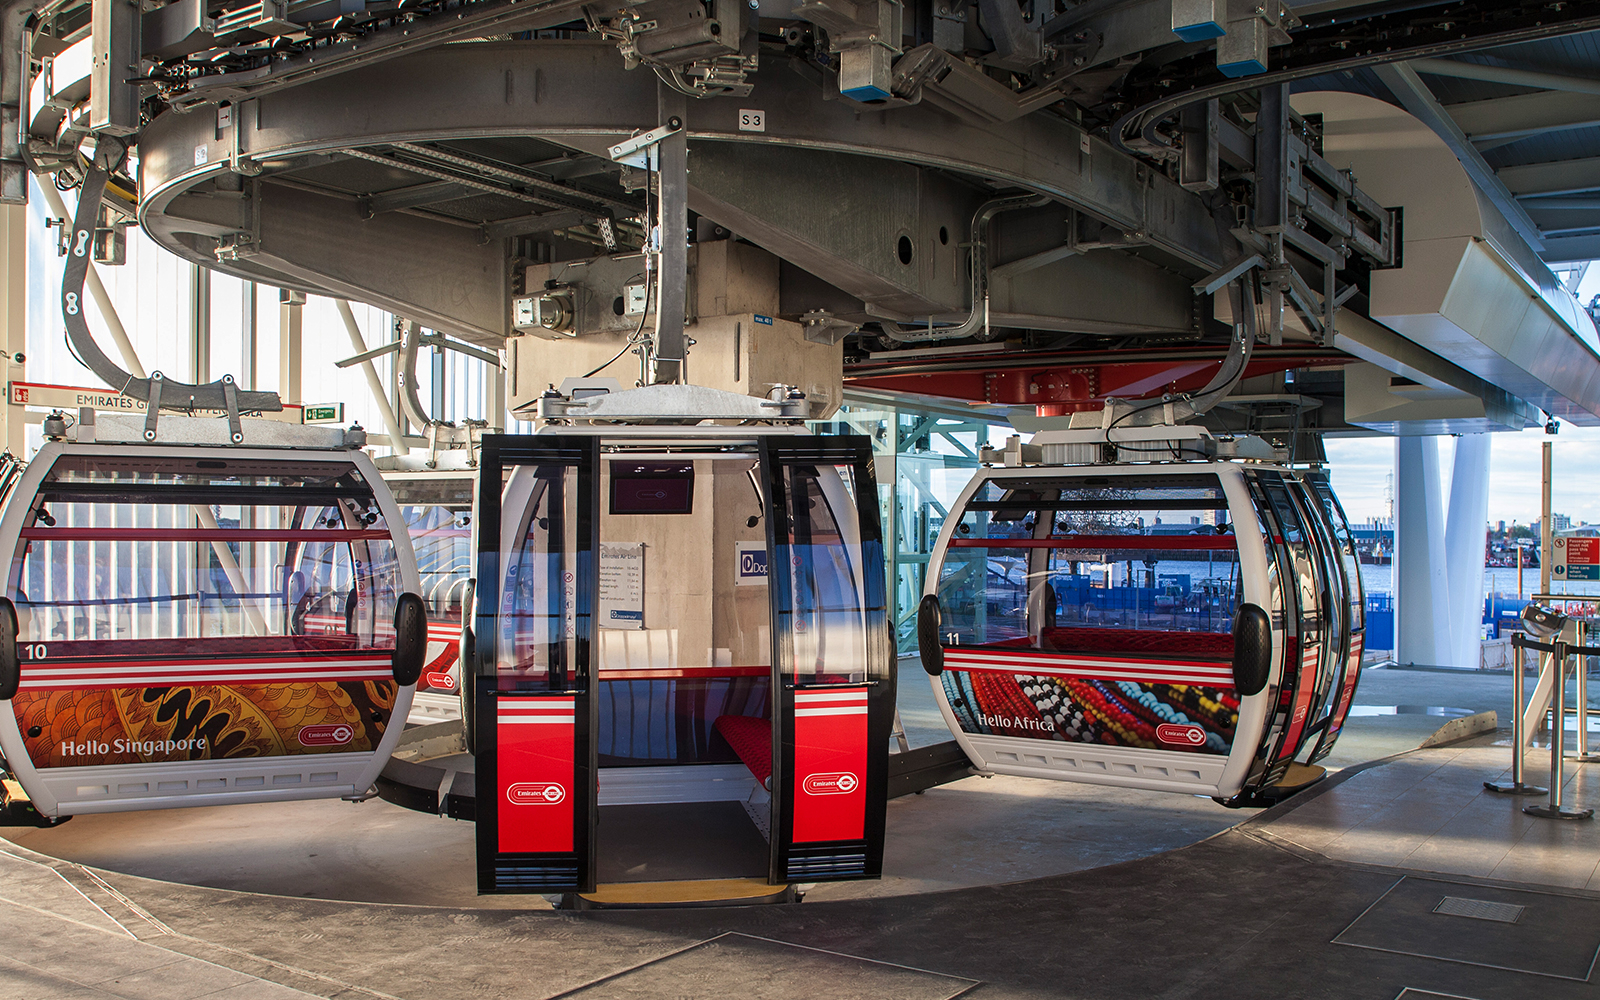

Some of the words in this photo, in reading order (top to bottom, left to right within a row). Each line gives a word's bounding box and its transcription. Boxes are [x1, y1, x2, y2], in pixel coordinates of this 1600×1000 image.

[76, 394, 133, 409] EMIRATES
[946, 632, 959, 646] 11
[24, 643, 48, 660] 10
[977, 713, 1011, 728] Hello
[1013, 715, 1055, 732] Africa
[61, 740, 110, 757] Hello
[113, 738, 206, 757] Singapore
